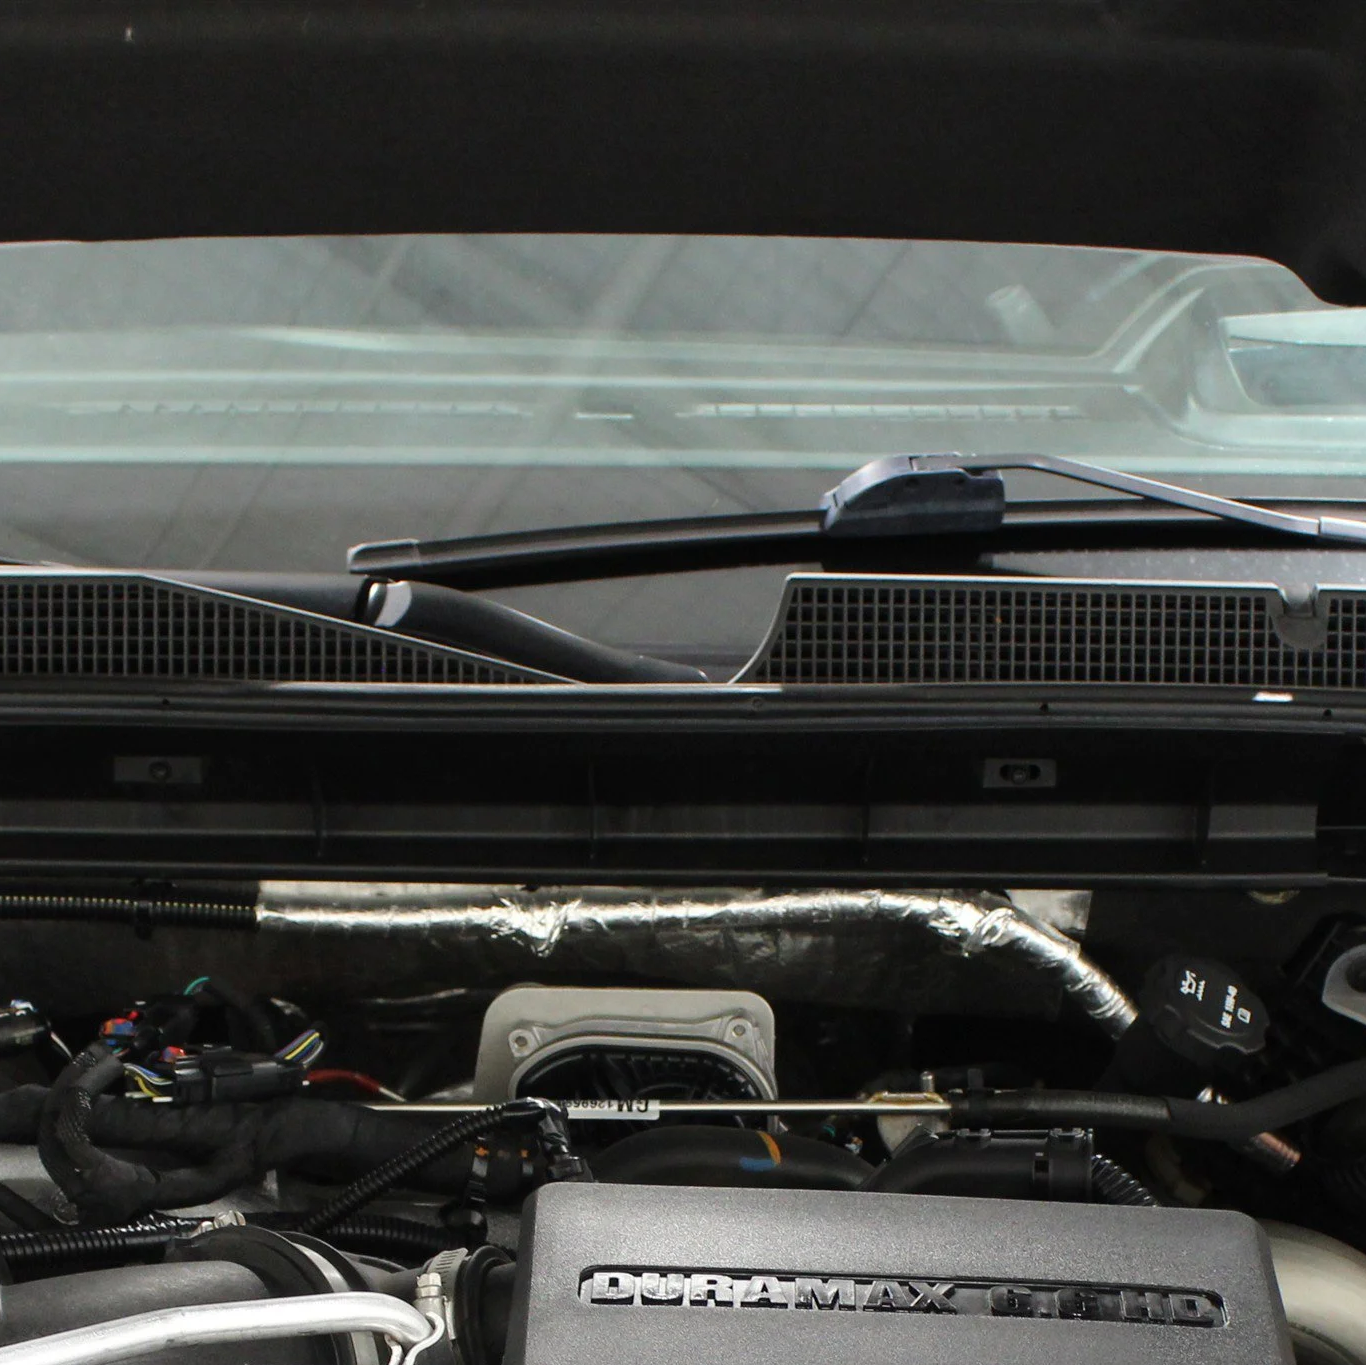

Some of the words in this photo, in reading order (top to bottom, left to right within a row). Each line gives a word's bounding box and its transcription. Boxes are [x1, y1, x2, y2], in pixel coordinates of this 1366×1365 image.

[617, 1099, 649, 1113] GM
[591, 1271, 957, 1314] DURAMAX
[987, 1285, 1098, 1319] 6.6
[1120, 1289, 1222, 1327] HD
